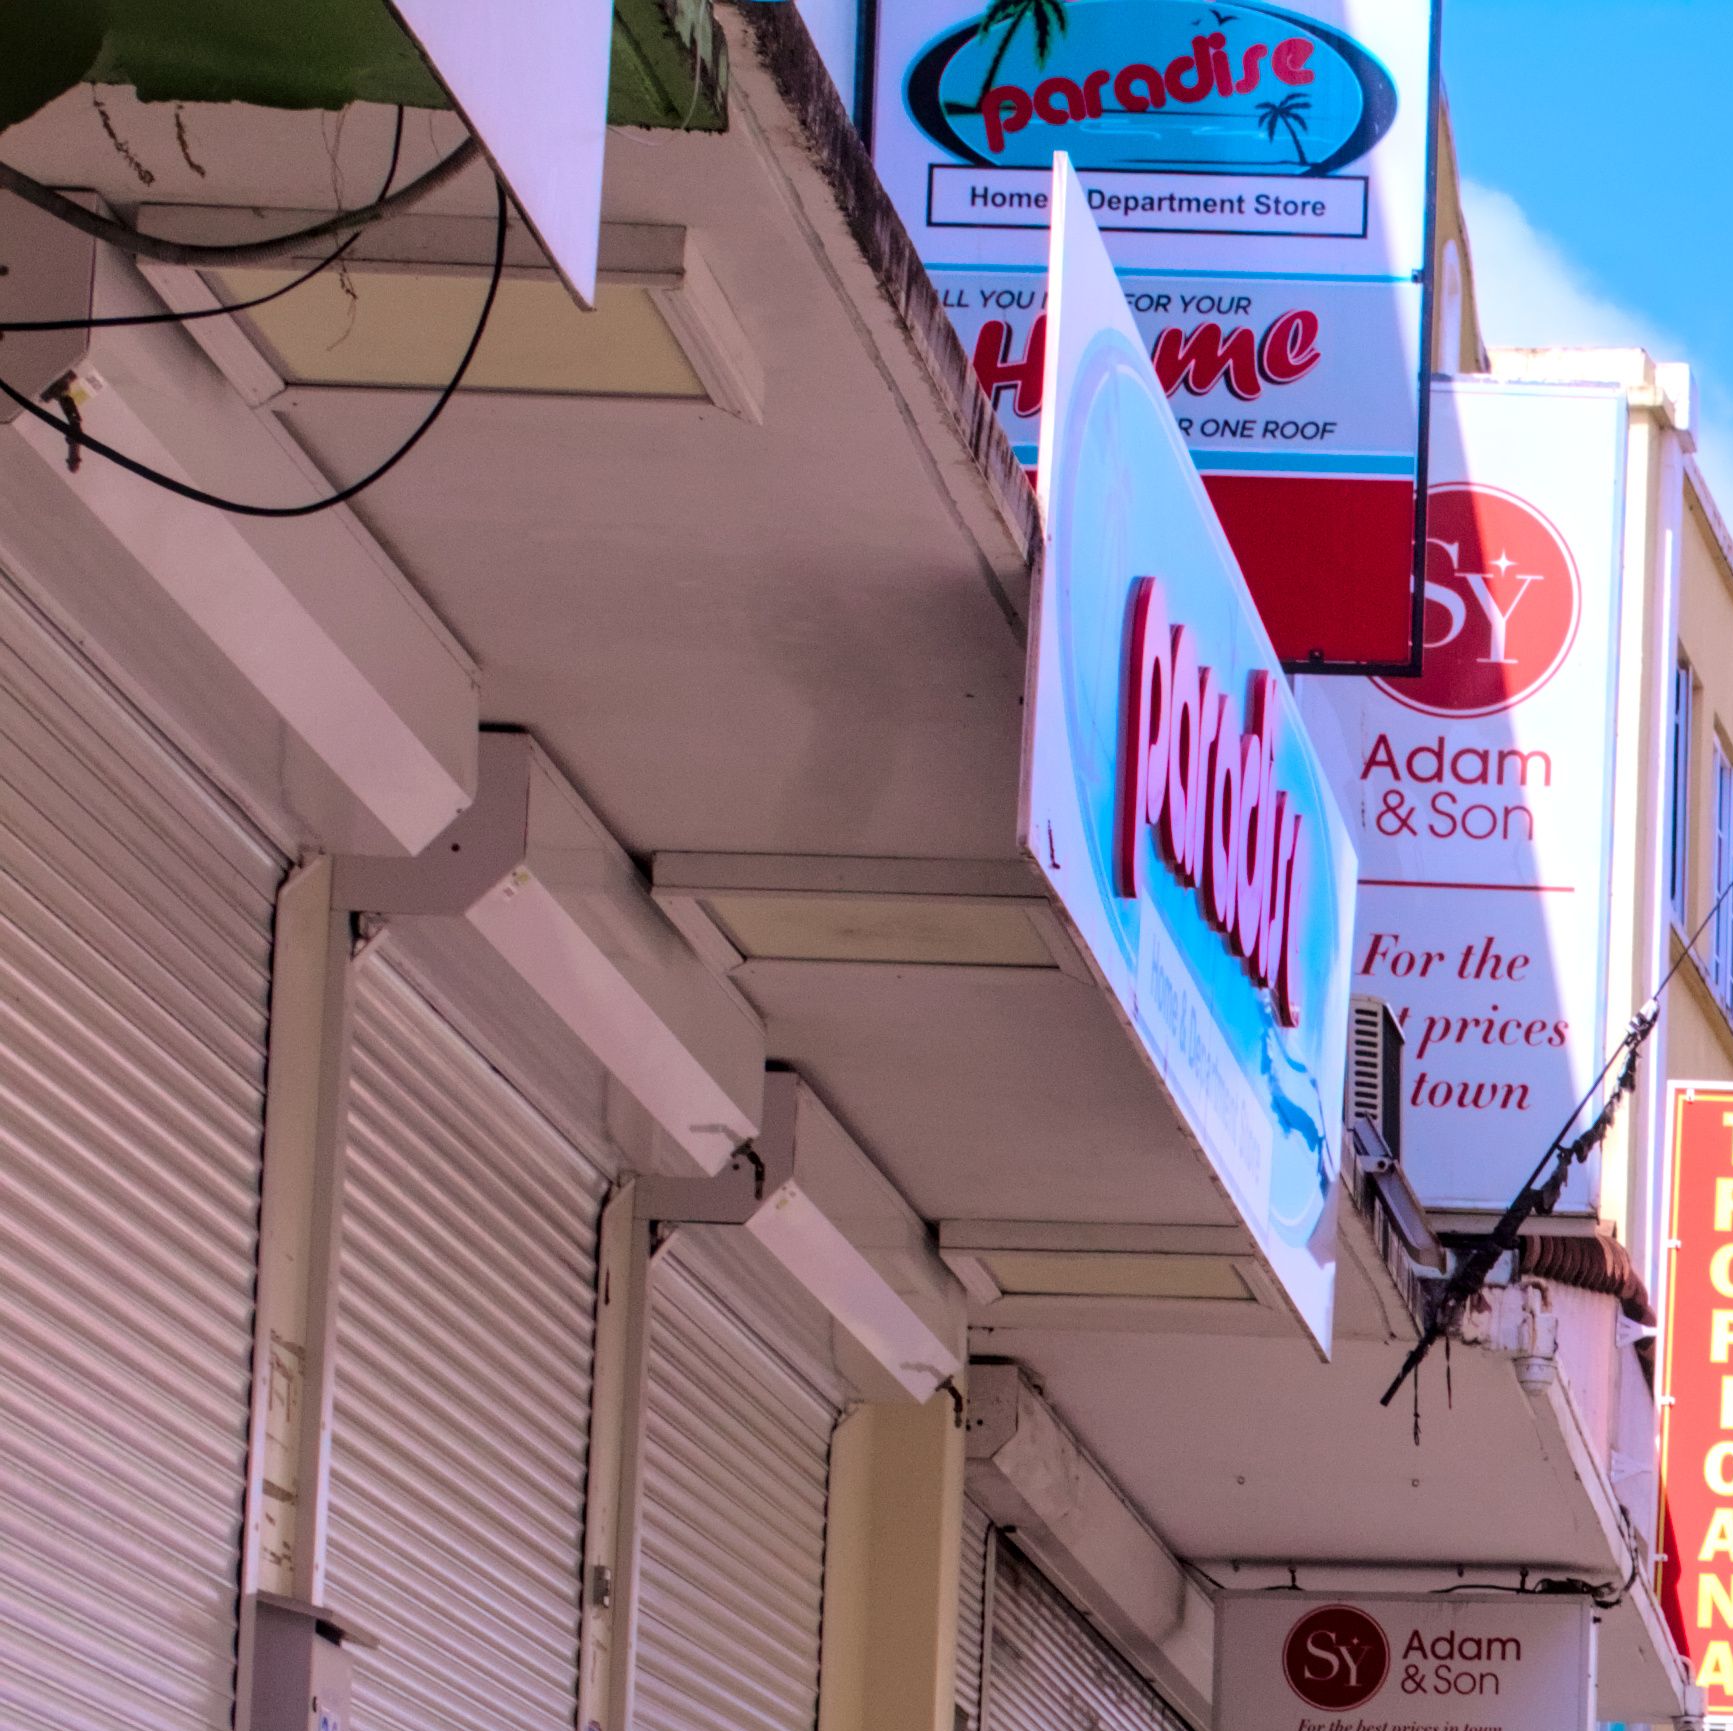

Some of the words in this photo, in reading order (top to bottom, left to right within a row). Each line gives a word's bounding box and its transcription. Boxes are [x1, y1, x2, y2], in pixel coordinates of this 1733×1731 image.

[981, 32, 1315, 154] paradise
[970, 186, 1047, 208] Home
[1087, 189, 1245, 216] Department
[1254, 194, 1326, 217] Store
[980, 289, 1034, 309] YOU
[1126, 295, 1170, 312] FOR
[1180, 295, 1251, 315] YOUR
[972, 308, 1322, 418] Hme
[1201, 418, 1255, 439] ONE
[1262, 420, 1337, 440] ROOF
[1360, 733, 1552, 787] Adam
[1376, 789, 1418, 837] &
[1429, 791, 1534, 841] Son
[1357, 933, 1445, 979] For
[1457, 936, 1531, 981] the
[1416, 1004, 1569, 1060] prices
[1409, 1072, 1531, 1111] town
[1304, 1630, 1369, 1687] SY
[1401, 1629, 1521, 1662] Adam
[1401, 1664, 1427, 1695] &
[1433, 1664, 1500, 1696] Son
